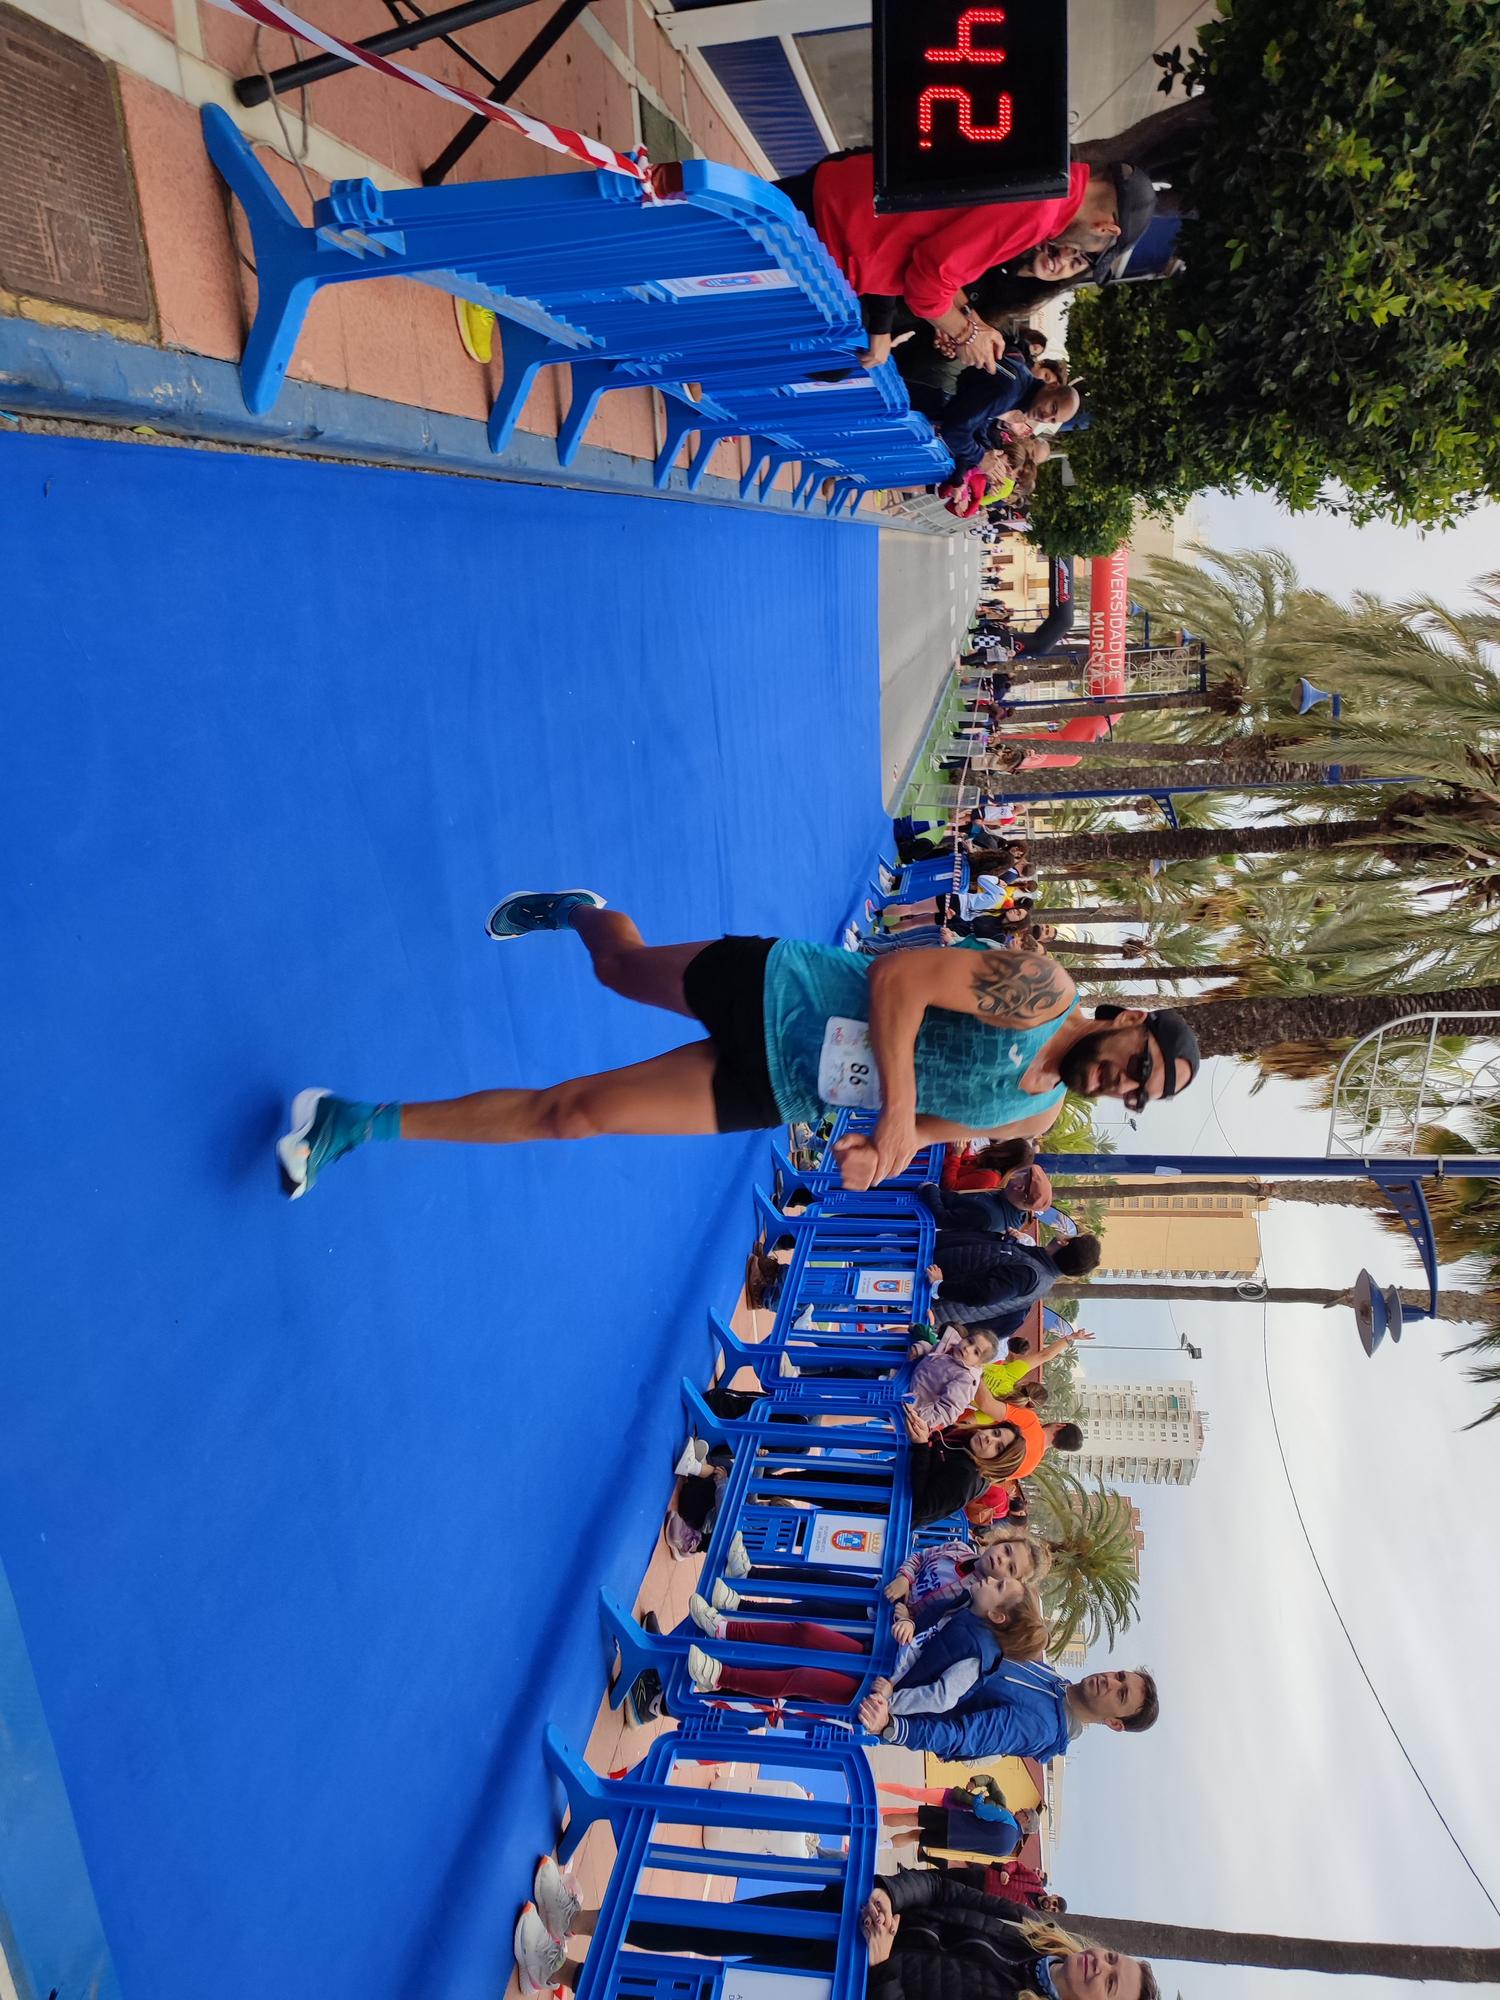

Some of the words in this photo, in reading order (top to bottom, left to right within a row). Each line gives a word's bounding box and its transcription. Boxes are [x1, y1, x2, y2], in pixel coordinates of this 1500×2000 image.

[1109, 549, 1125, 652] NIVERSIDAD
[1090, 611, 1106, 680] MURCIA
[1108, 658, 1122, 681] DE
[848, 1063, 870, 1086] 86
